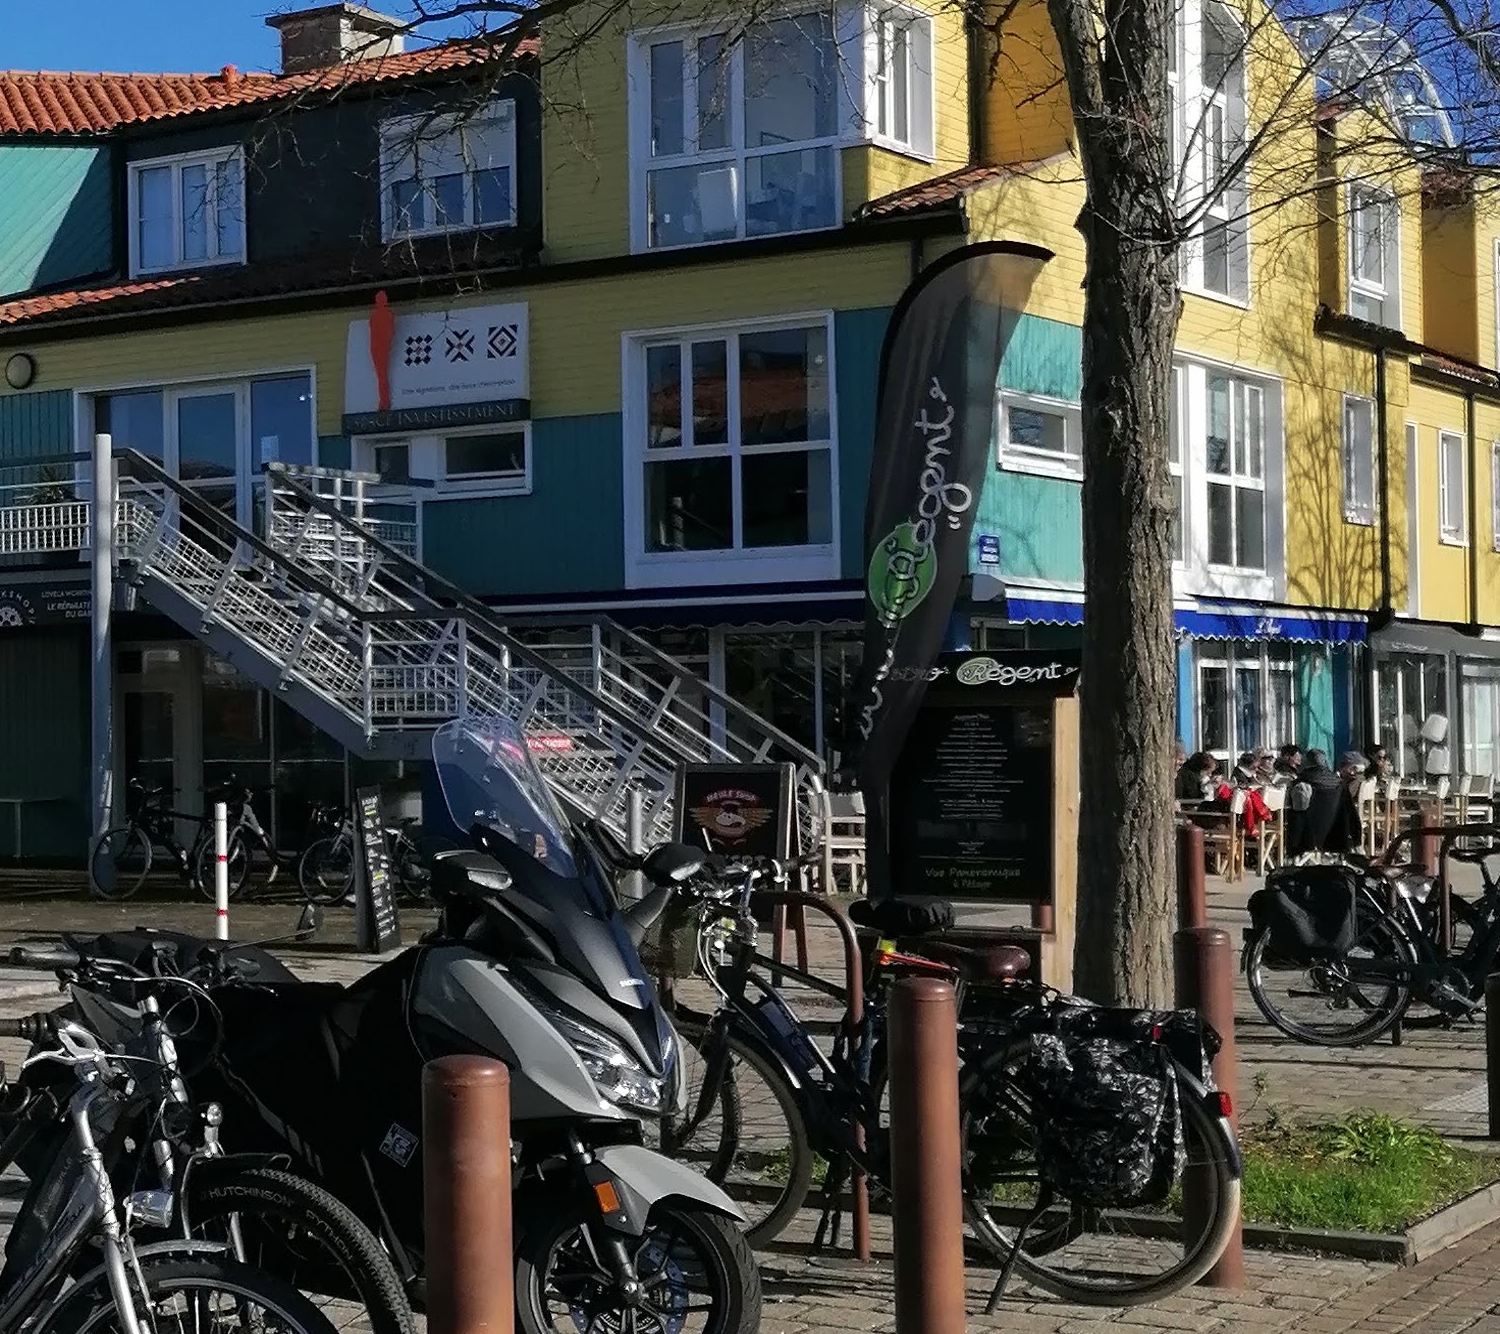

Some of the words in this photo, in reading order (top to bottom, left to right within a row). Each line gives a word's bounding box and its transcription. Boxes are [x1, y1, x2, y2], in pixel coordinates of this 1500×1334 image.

[398, 404, 514, 425] INVESTISSEMENT
[964, 660, 1063, 686] Régent
[209, 1186, 293, 1207] HUTCHINSON
[305, 1209, 353, 1261] PYTHON
